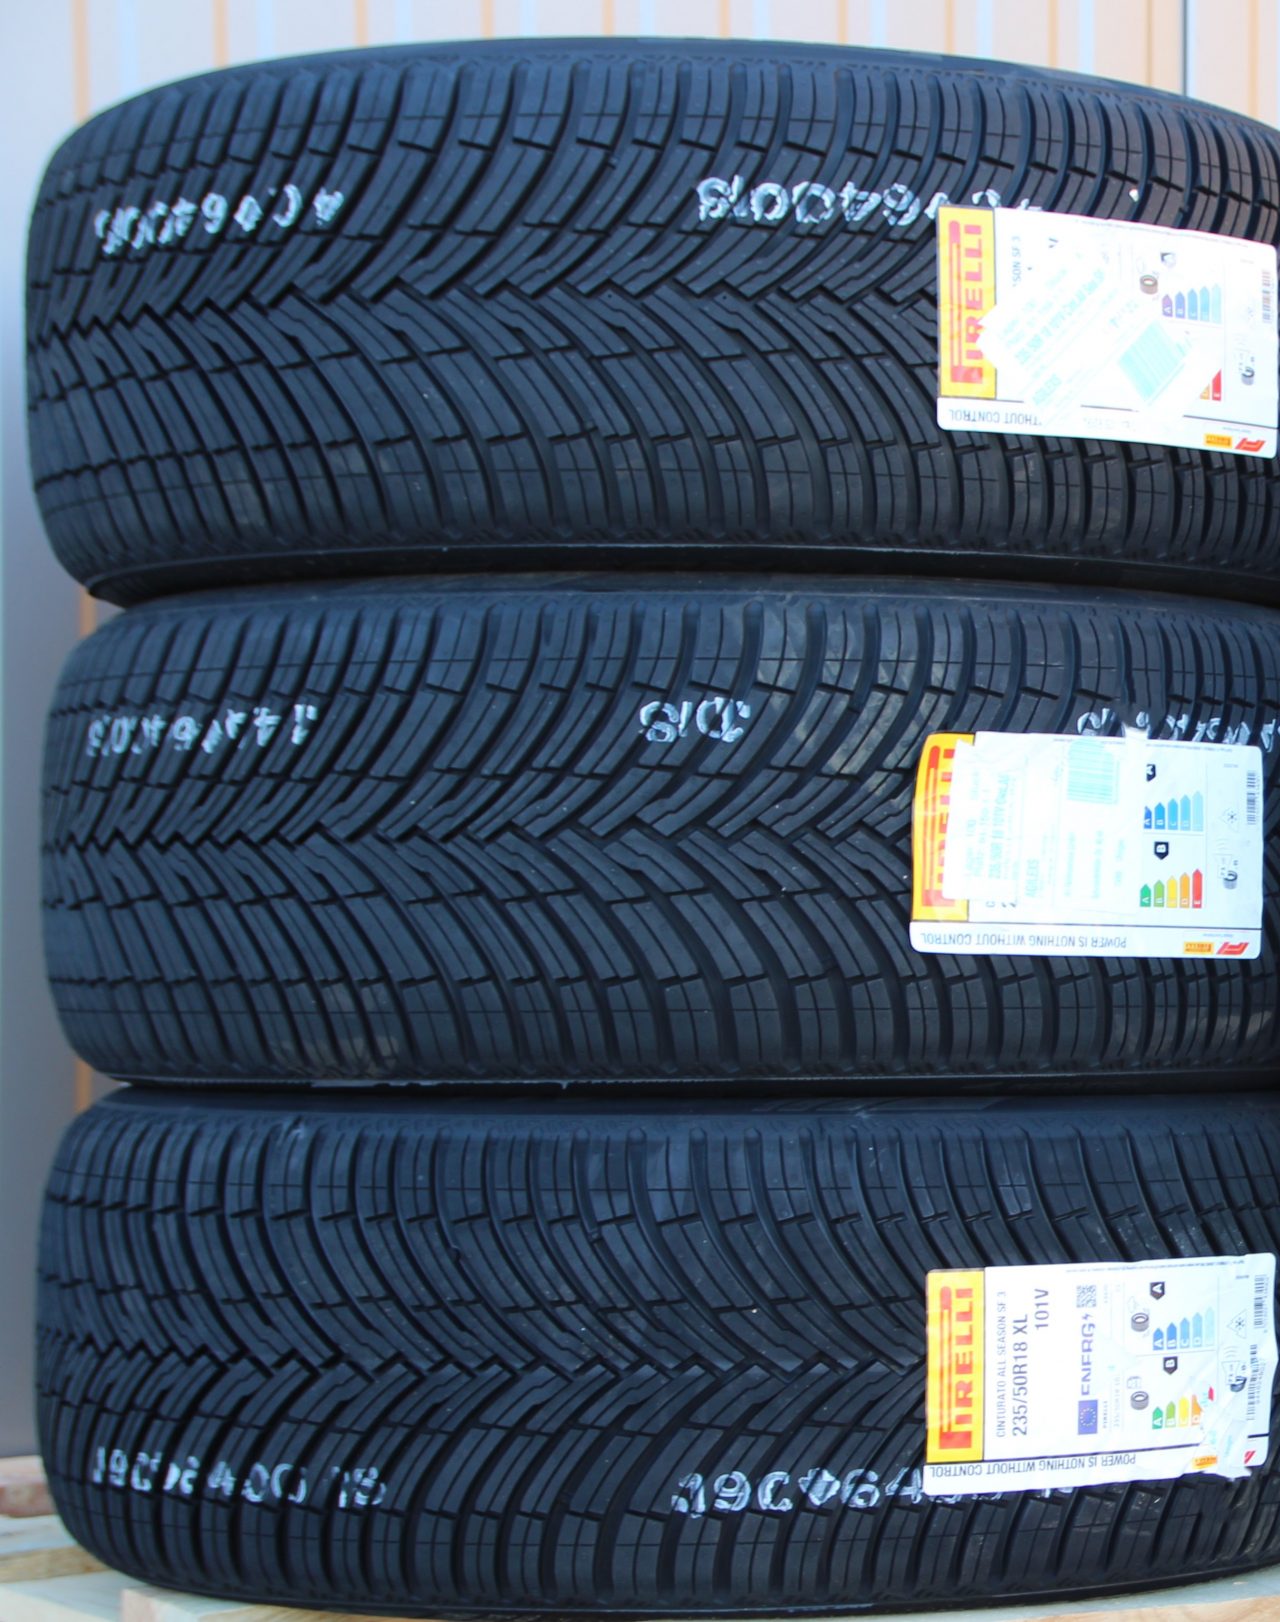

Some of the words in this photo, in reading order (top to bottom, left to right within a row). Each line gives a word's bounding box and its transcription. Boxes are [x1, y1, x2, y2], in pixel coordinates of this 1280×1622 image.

[1011, 261, 1021, 287] SON
[950, 219, 984, 384] PIRELLI
[949, 408, 1000, 423] CONTROL
[1004, 412, 1042, 426] THOUT
[920, 932, 971, 945] CONTROL
[973, 933, 1027, 946] WITHOUT
[1028, 935, 1077, 947] NOTHING
[1079, 935, 1088, 947] IS
[1090, 935, 1127, 949] POWER
[997, 1302, 1007, 1314] SF
[1034, 1288, 1050, 1330] 101V
[1012, 1314, 1028, 1336] XL
[996, 1315, 1007, 1356] SEASON
[938, 1286, 974, 1450] PIRELLI
[996, 1359, 1007, 1377] ALL
[1012, 1341, 1029, 1437] 235/50R18
[996, 1380, 1007, 1438] CINTURATO
[986, 1459, 1036, 1475] WITHOUT
[1039, 1456, 1085, 1472] NOTHING
[1088, 1456, 1097, 1468] IS
[1101, 1453, 1136, 1467] POWER
[931, 1464, 982, 1478] CONTROL
